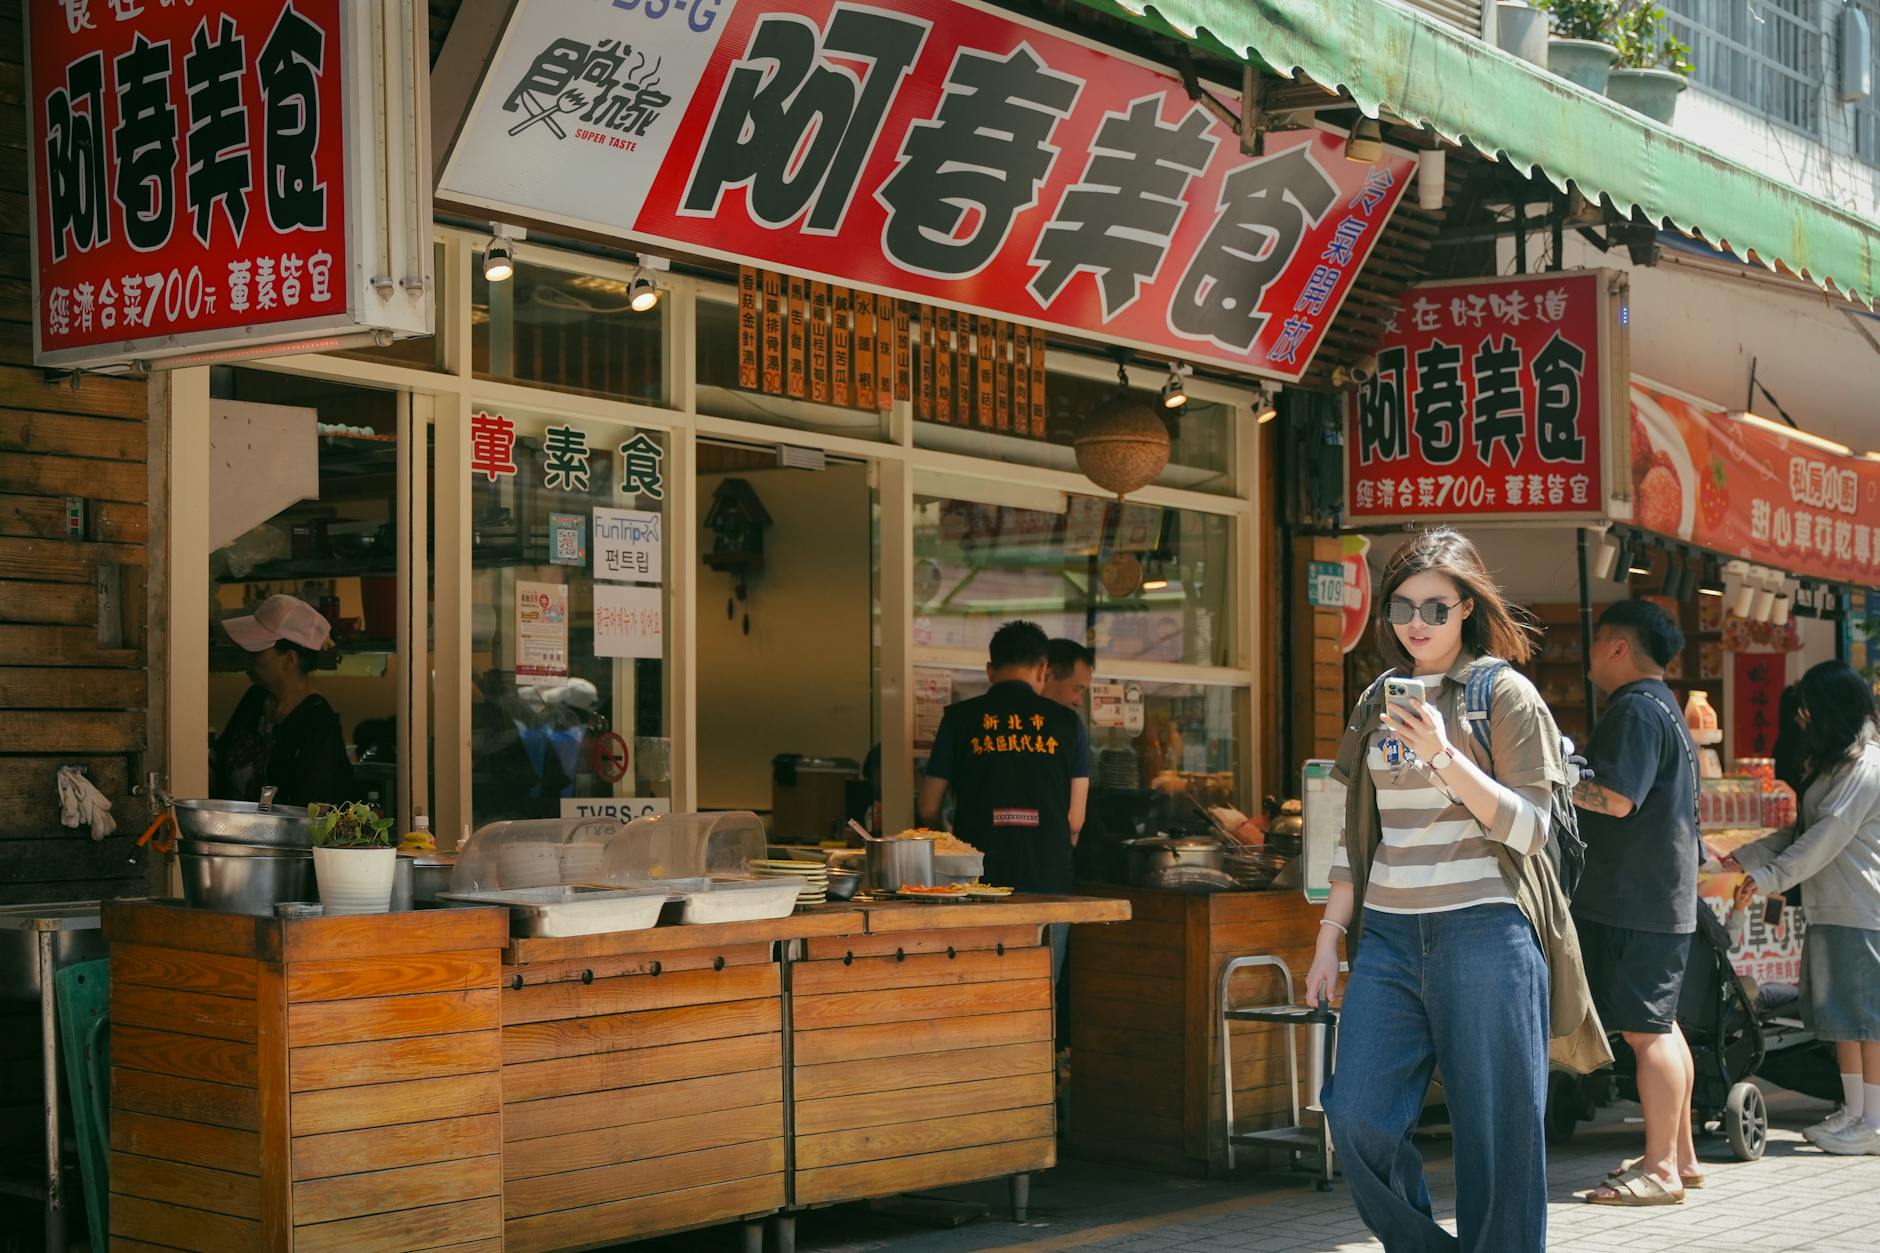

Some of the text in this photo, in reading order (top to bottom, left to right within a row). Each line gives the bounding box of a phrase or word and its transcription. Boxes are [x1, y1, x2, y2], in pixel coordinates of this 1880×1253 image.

[45, 0, 327, 264] 阿春美食
[574, 128, 638, 152] SUPER TASTE
[675, 4, 1342, 356] 阿春美食
[49, 249, 333, 336] 經濟合菜700元 葷素皆宜
[1266, 166, 1394, 365] 冷氣開放
[605, 549, 649, 574] 펀트립
[1320, 579, 1342, 601] 109
[982, 713, 1046, 732] 新北市
